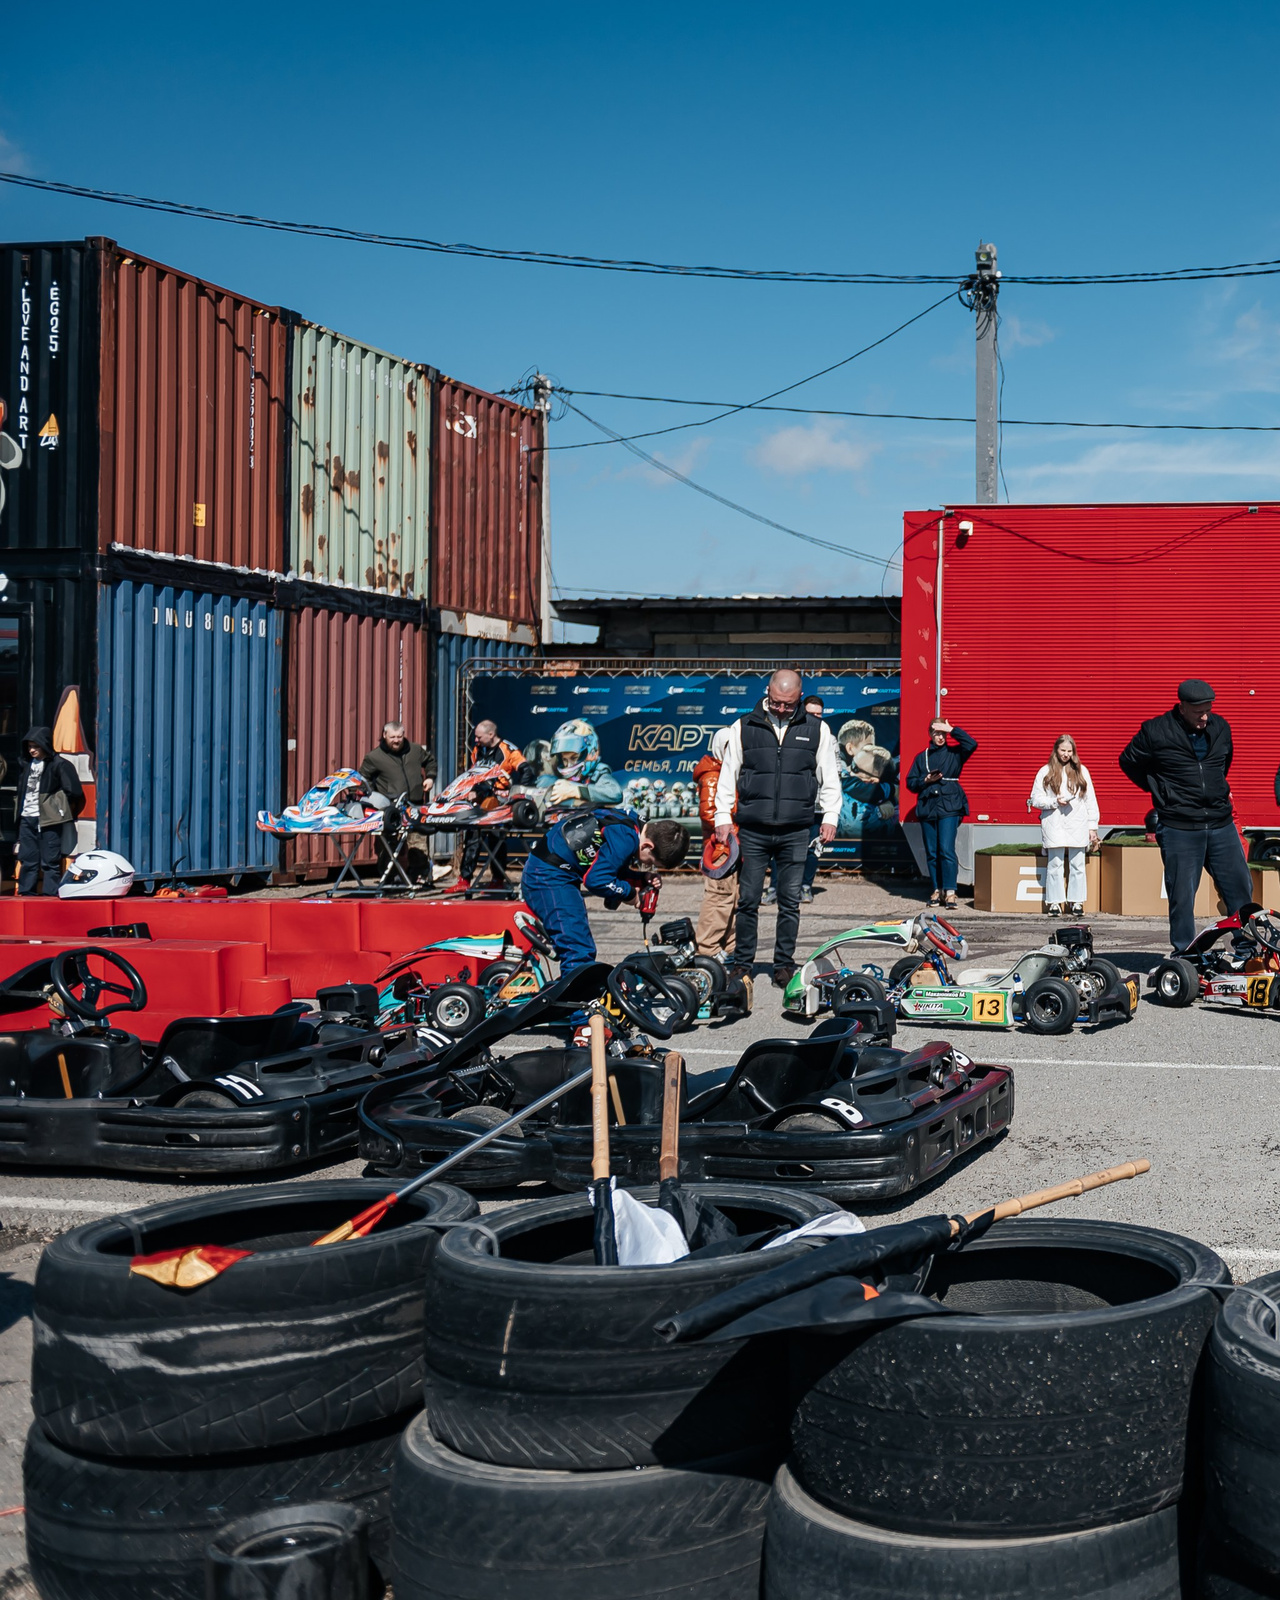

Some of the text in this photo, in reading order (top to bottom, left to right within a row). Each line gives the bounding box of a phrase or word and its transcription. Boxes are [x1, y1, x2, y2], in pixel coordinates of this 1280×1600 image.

[624, 760, 673, 774] СЕМЬЯ,
[1249, 978, 1269, 1004] 18
[977, 999, 1000, 1016] 13
[214, 1074, 264, 1100] 11
[820, 1097, 864, 1125] 8
